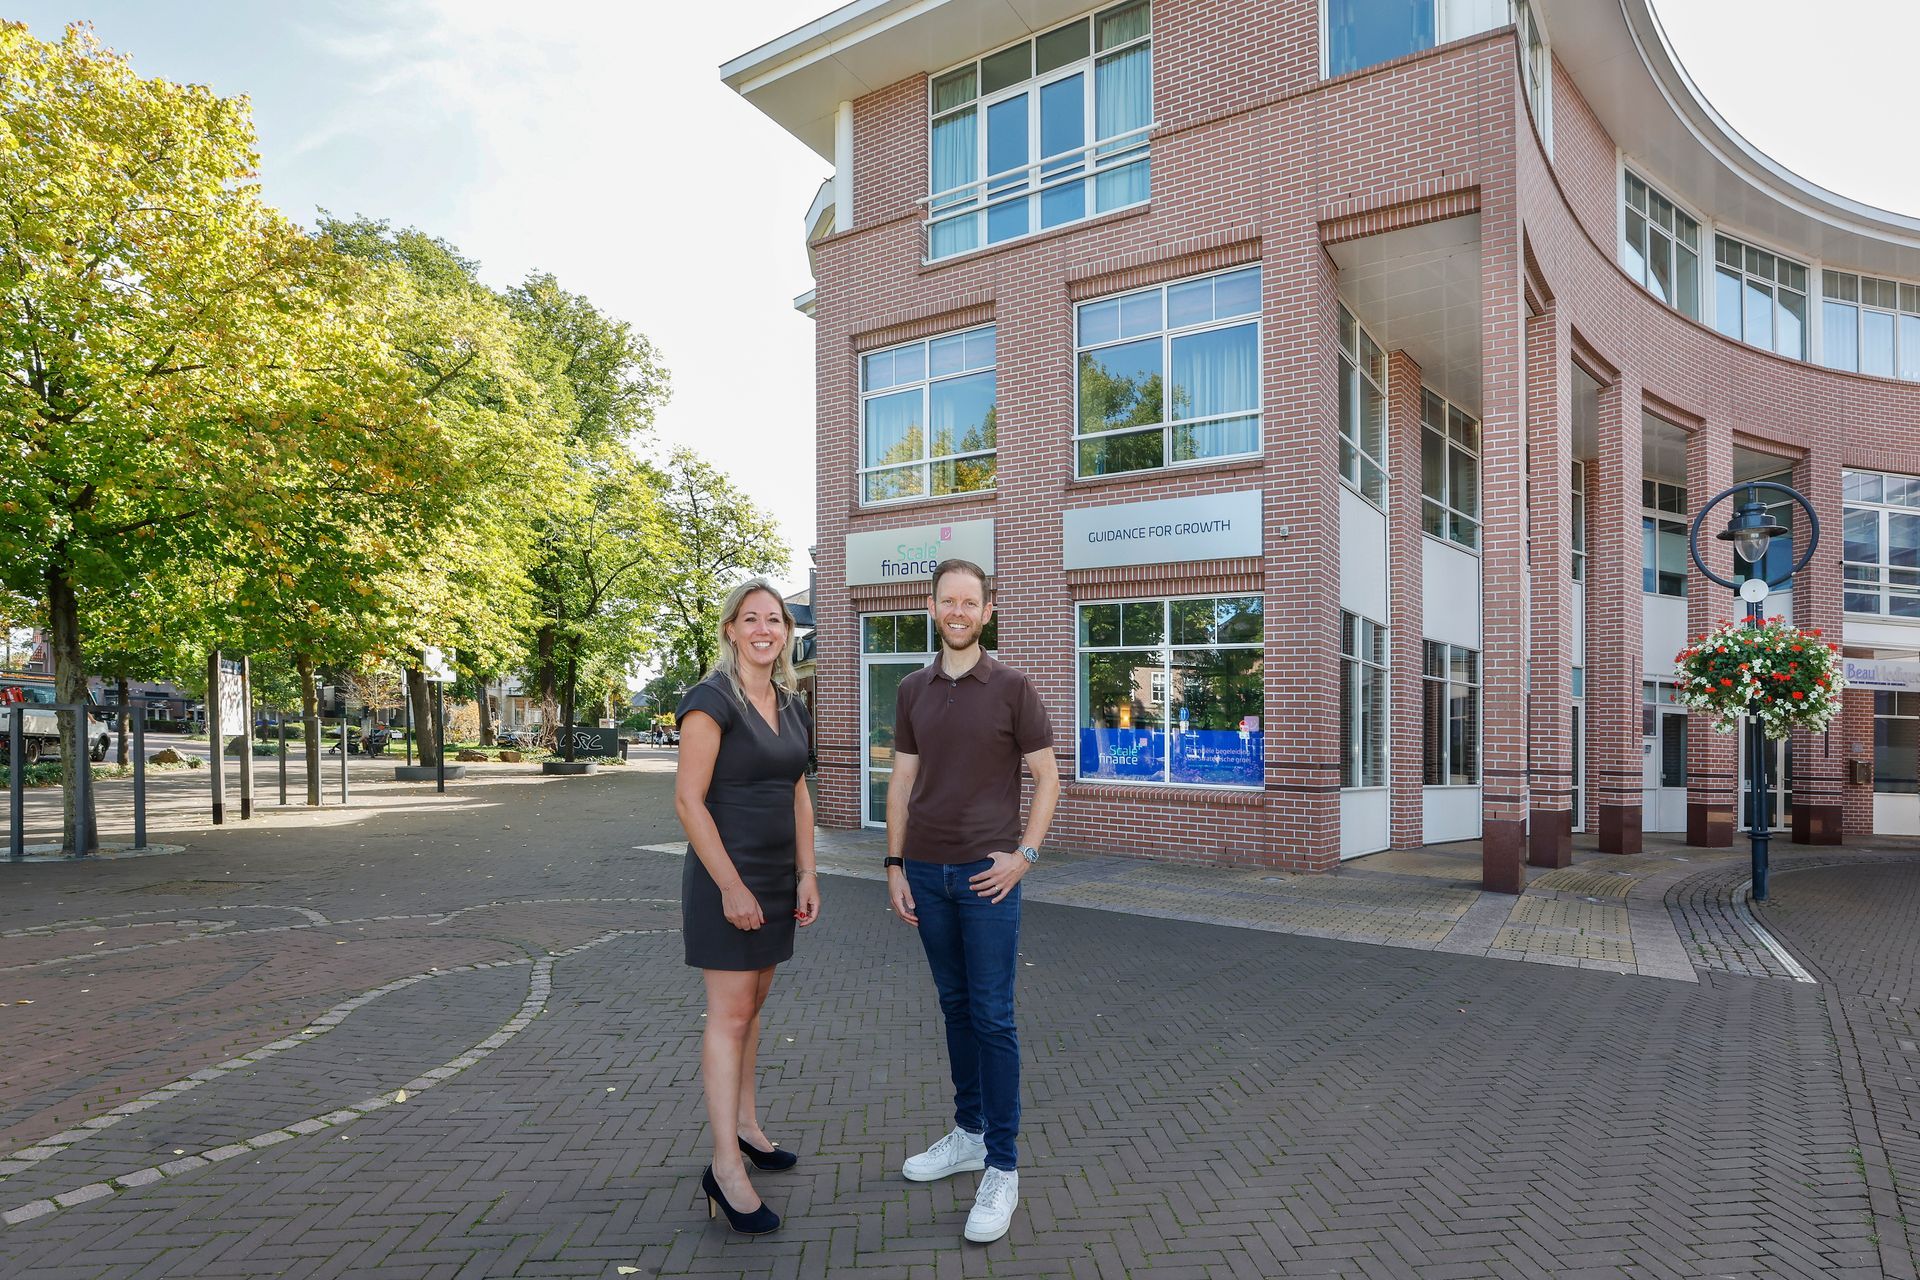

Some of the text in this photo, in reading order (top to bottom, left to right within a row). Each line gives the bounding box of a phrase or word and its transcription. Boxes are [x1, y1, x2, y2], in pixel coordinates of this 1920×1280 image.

[1088, 519, 1231, 543] GUIDANCE FOR GROWTH
[896, 542, 937, 562] Scale
[881, 559, 938, 577] finance
[1098, 752, 1138, 765] finance
[1109, 744, 1138, 756] Scale
